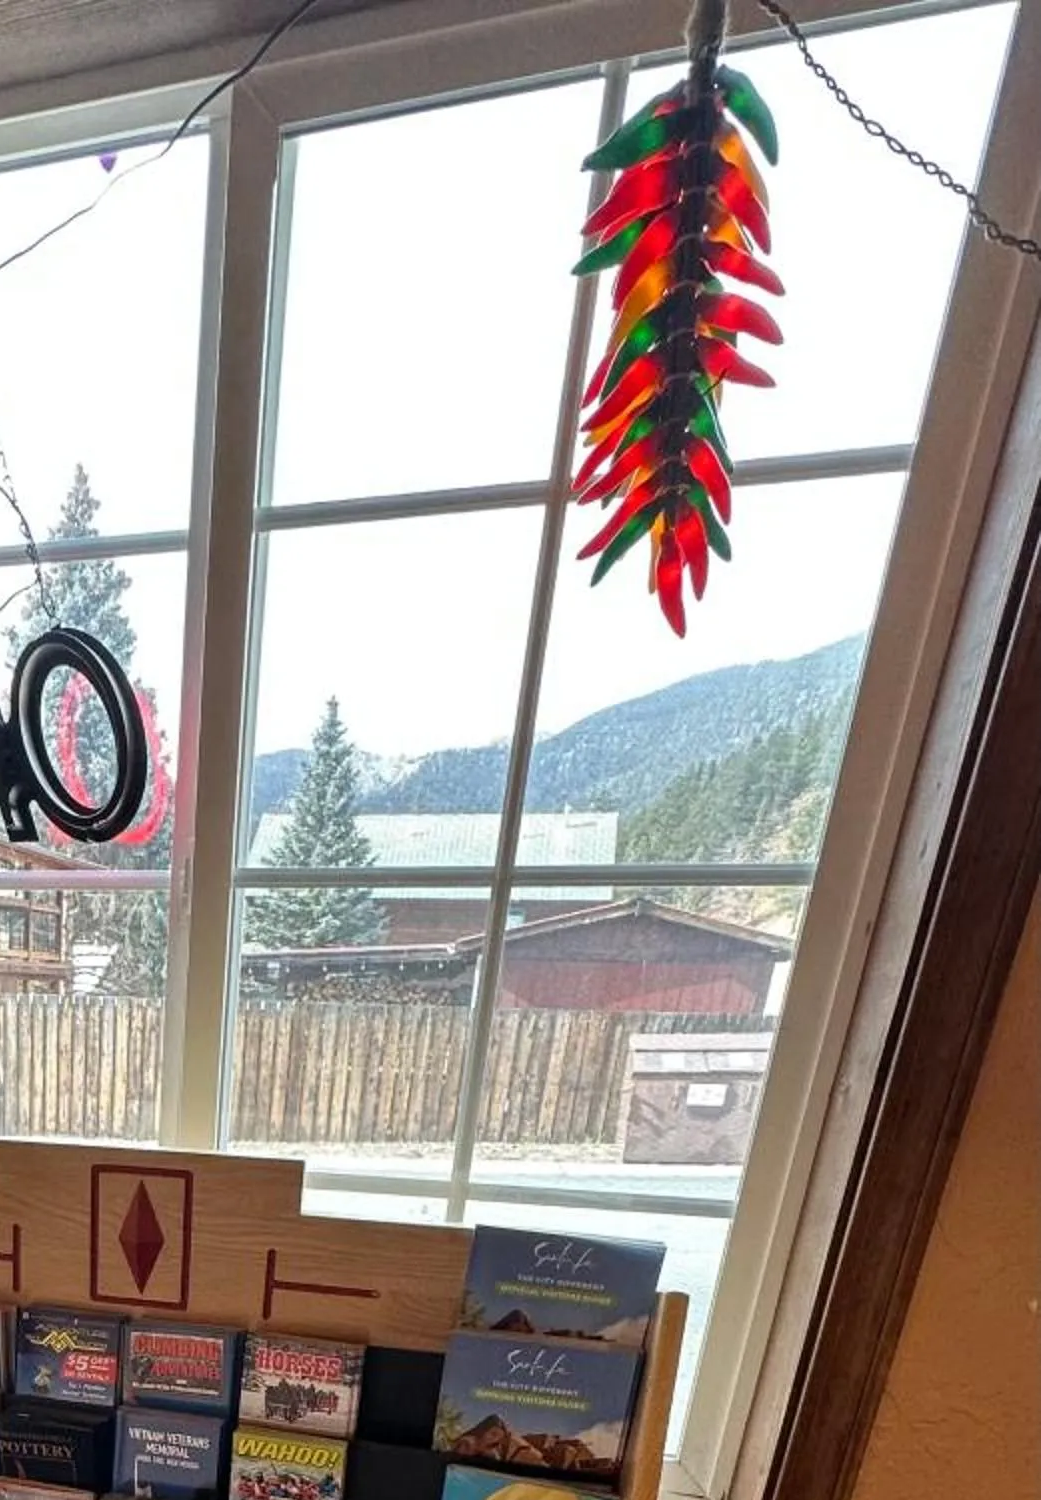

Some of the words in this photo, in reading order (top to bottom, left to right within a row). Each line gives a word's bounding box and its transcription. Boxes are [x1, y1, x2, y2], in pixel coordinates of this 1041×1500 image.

[65, 1353, 90, 1372] $5
[258, 1347, 342, 1379] HORSES
[238, 1438, 341, 1469] WAHOO!
